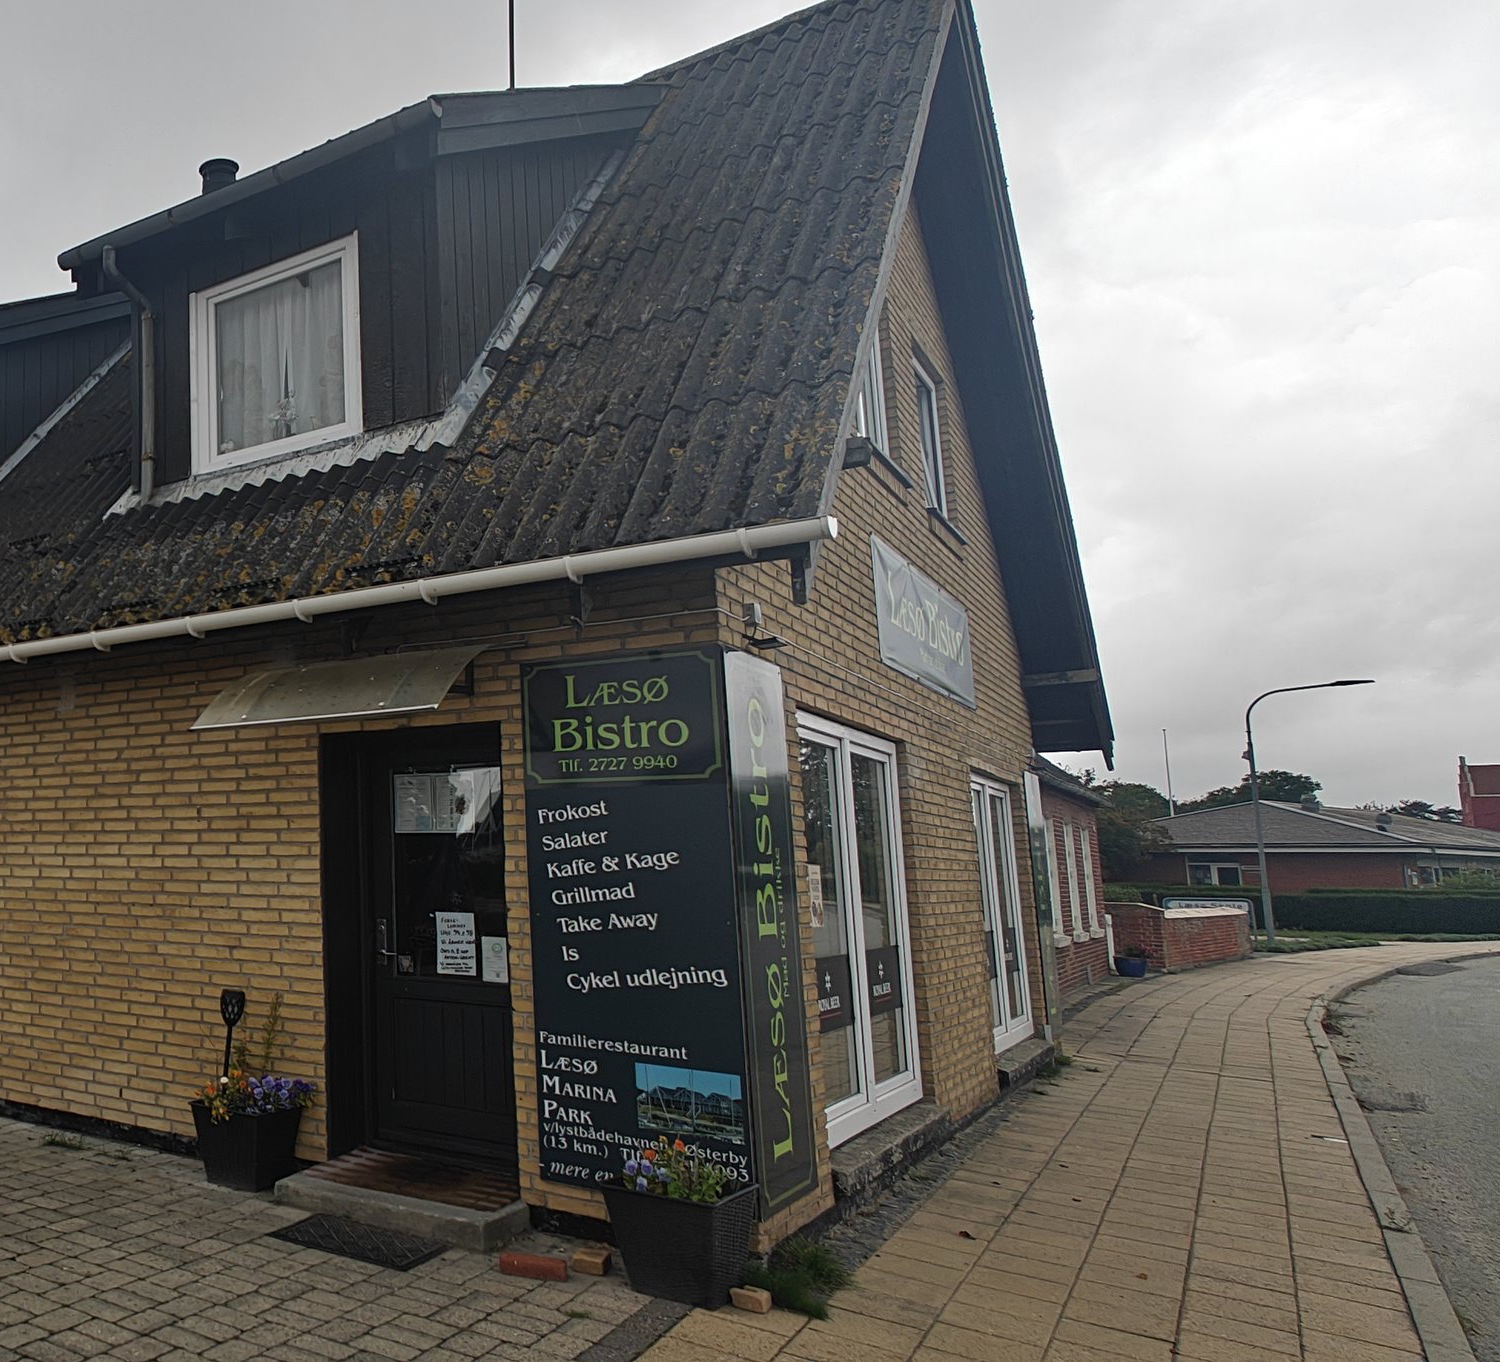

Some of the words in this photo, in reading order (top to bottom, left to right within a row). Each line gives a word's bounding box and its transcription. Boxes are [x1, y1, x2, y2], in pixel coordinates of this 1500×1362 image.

[926, 600, 965, 667] Bistro
[564, 674, 669, 709] LÆSØ
[551, 714, 690, 752] Bistro
[558, 758, 584, 772] Tlf.
[588, 757, 627, 771] 2727
[632, 754, 678, 770] 9940
[537, 800, 609, 824] Frokost
[747, 697, 779, 942] Bistro
[542, 830, 609, 851] Salater
[546, 858, 597, 879] Kaffe
[601, 855, 621, 872] &
[625, 851, 681, 871] Kage
[551, 882, 636, 905] Grillmad
[556, 915, 603, 933] Take
[607, 912, 659, 930] Away
[561, 946, 580, 961] Is
[566, 971, 621, 993] Cykel
[626, 966, 729, 989] udlejning
[539, 1030, 688, 1060] Familierestaurant
[540, 1049, 598, 1075] LÆSØ
[765, 962, 794, 1164] LÆSØ
[542, 1074, 617, 1103] MARINA
[543, 1099, 593, 1125] PARK
[543, 1134, 568, 1149] (13
[573, 1139, 609, 1159] km.)
[684, 1143, 748, 1168] Østerby
[550, 1161, 590, 1180] mere
